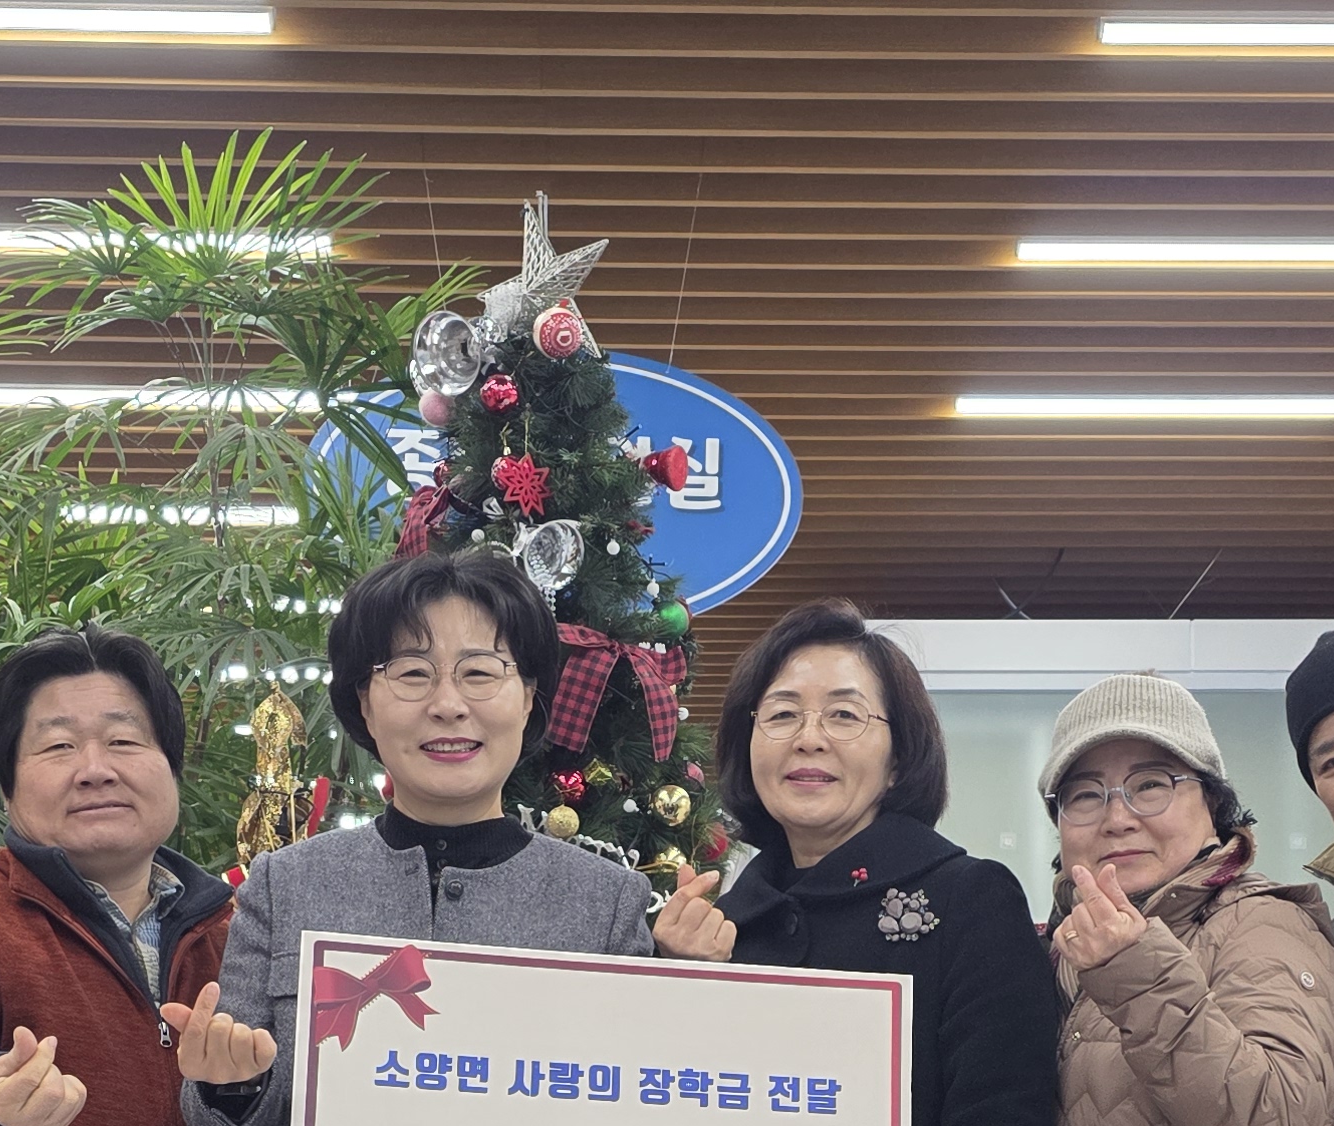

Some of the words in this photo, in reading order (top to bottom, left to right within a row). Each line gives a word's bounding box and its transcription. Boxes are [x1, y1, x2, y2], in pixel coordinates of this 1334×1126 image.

[374, 1050, 490, 1093] 소양면
[507, 1060, 621, 1102] 사랑의
[639, 1067, 752, 1110] 장학금
[767, 1075, 842, 1115] 전달
